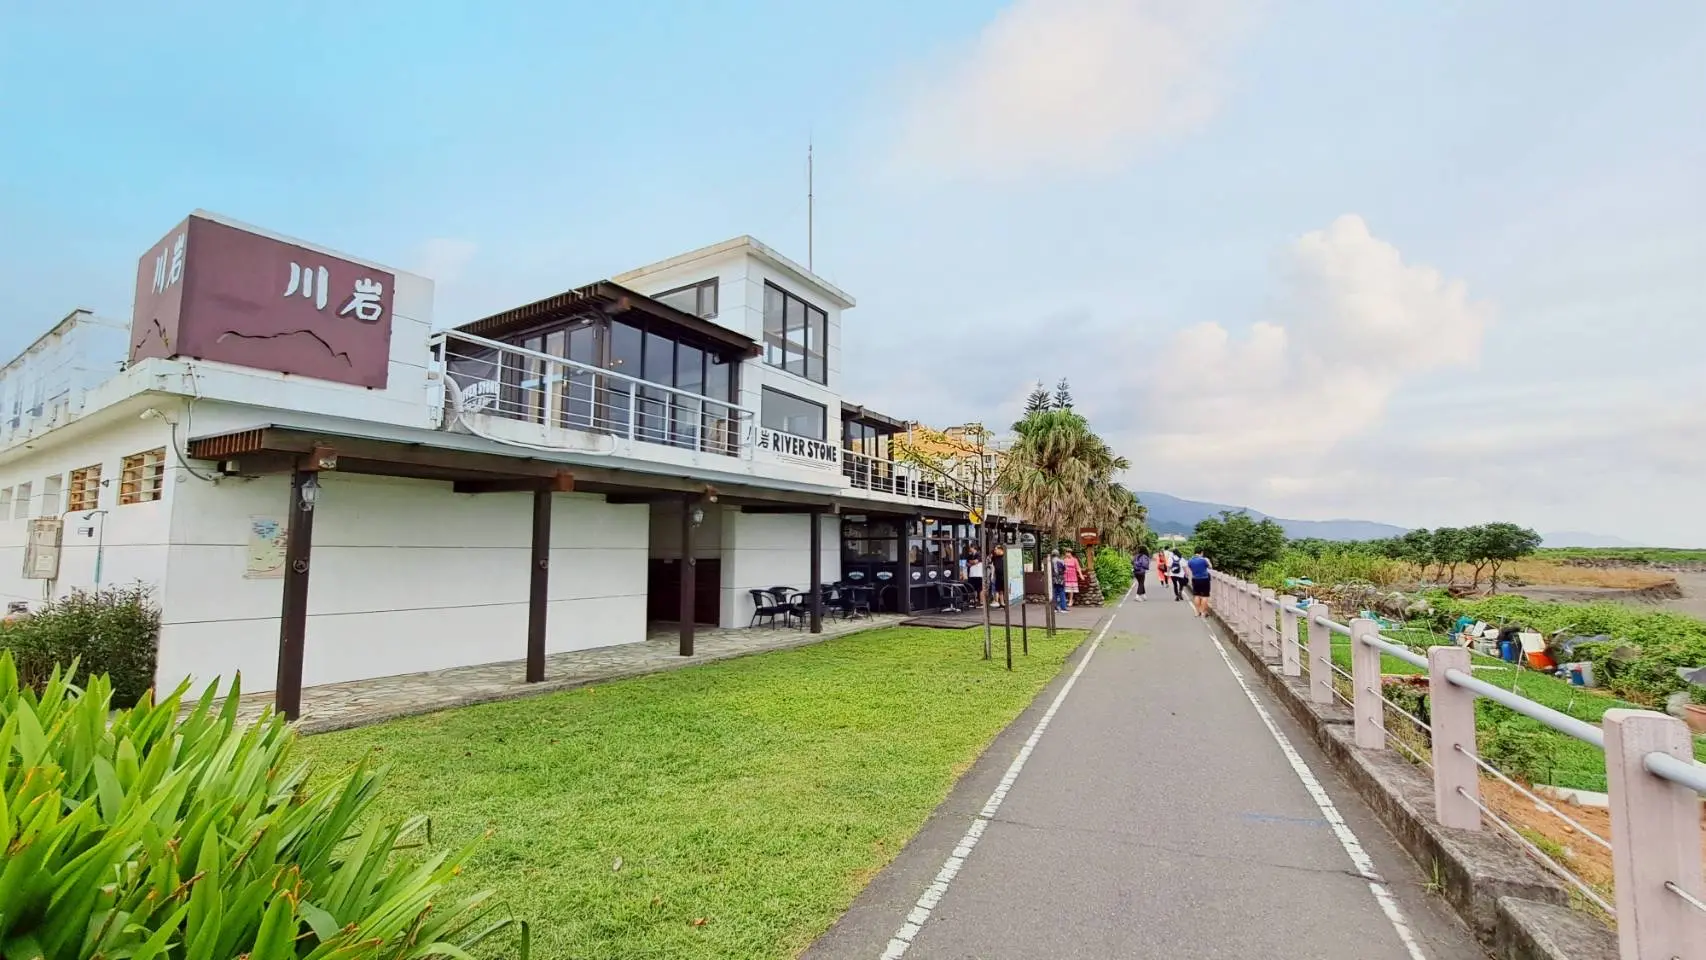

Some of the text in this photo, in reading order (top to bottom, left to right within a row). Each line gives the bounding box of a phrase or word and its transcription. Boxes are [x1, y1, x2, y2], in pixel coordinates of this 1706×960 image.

[152, 233, 185, 294] 川岩
[284, 262, 383, 321] 川岩
[773, 432, 805, 456] RIVER
[807, 441, 837, 462] STONE
